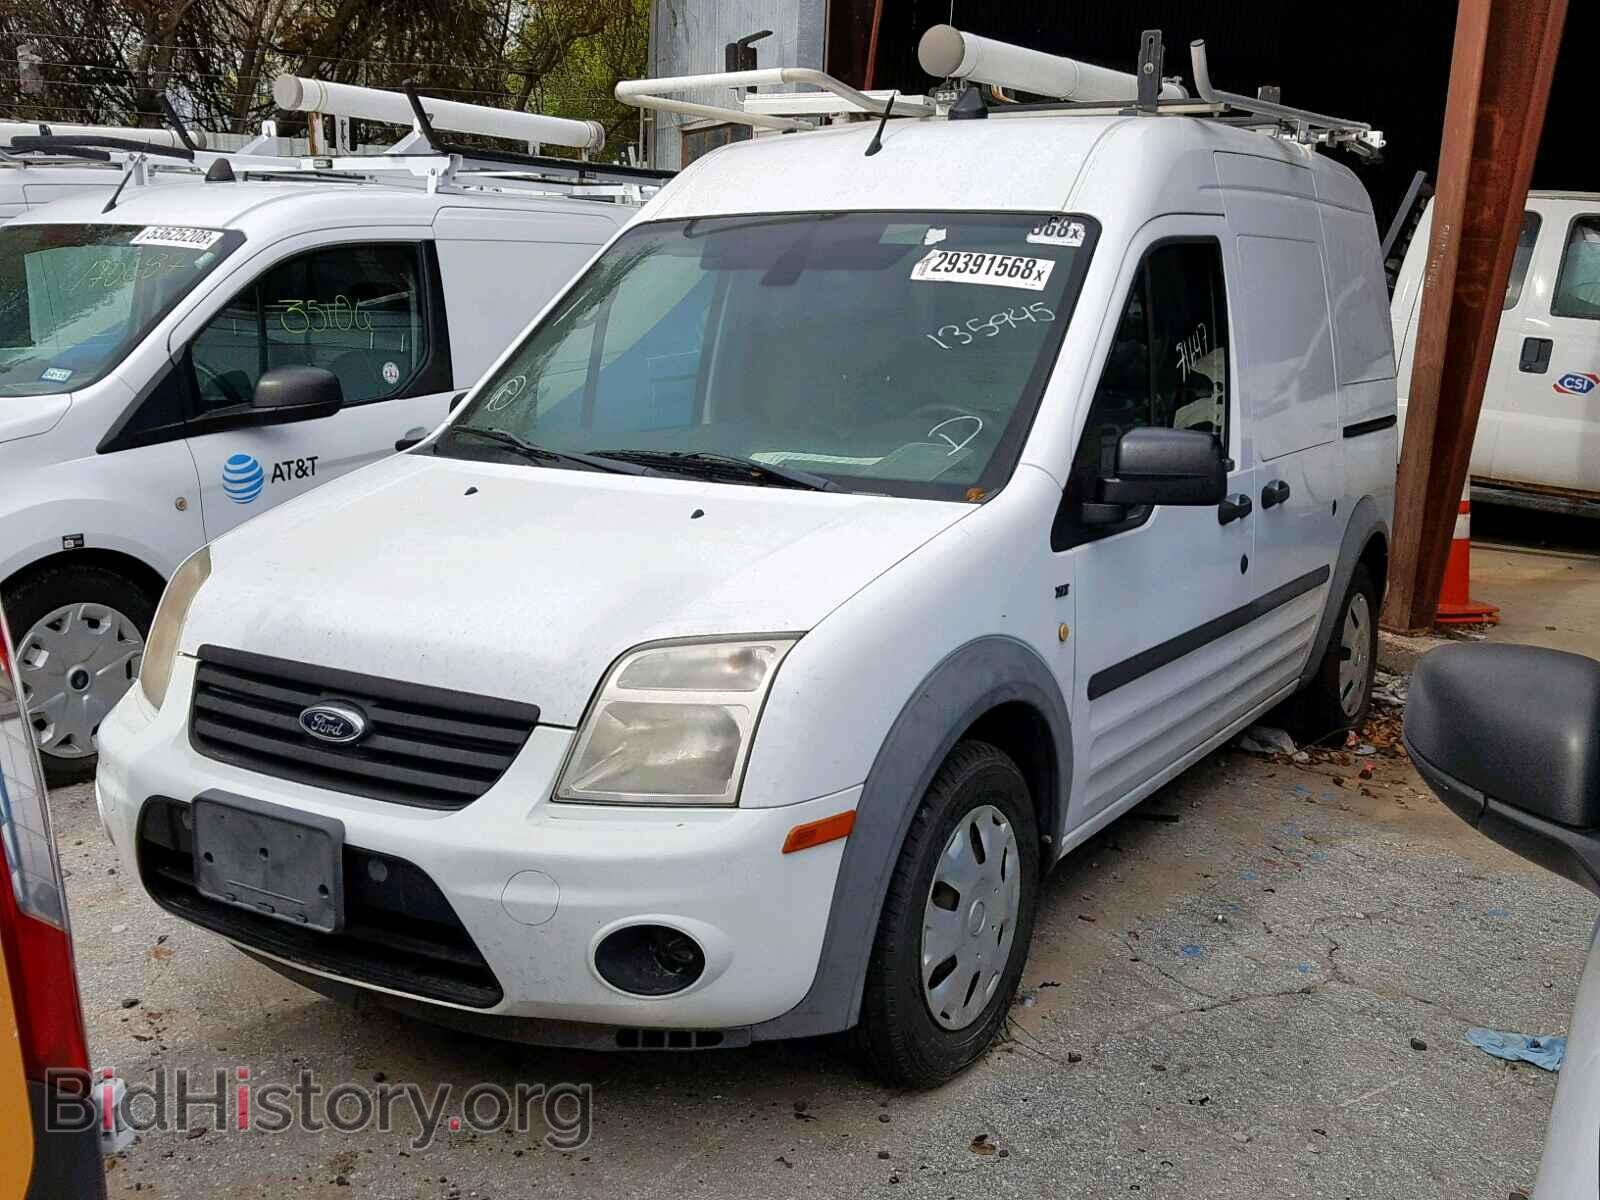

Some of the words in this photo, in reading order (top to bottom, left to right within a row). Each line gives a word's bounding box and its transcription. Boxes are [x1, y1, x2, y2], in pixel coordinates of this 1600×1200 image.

[926, 302, 1056, 349] 135945
[1563, 377, 1589, 391] CSI
[271, 456, 319, 484] AT&T
[309, 712, 345, 737] Ford
